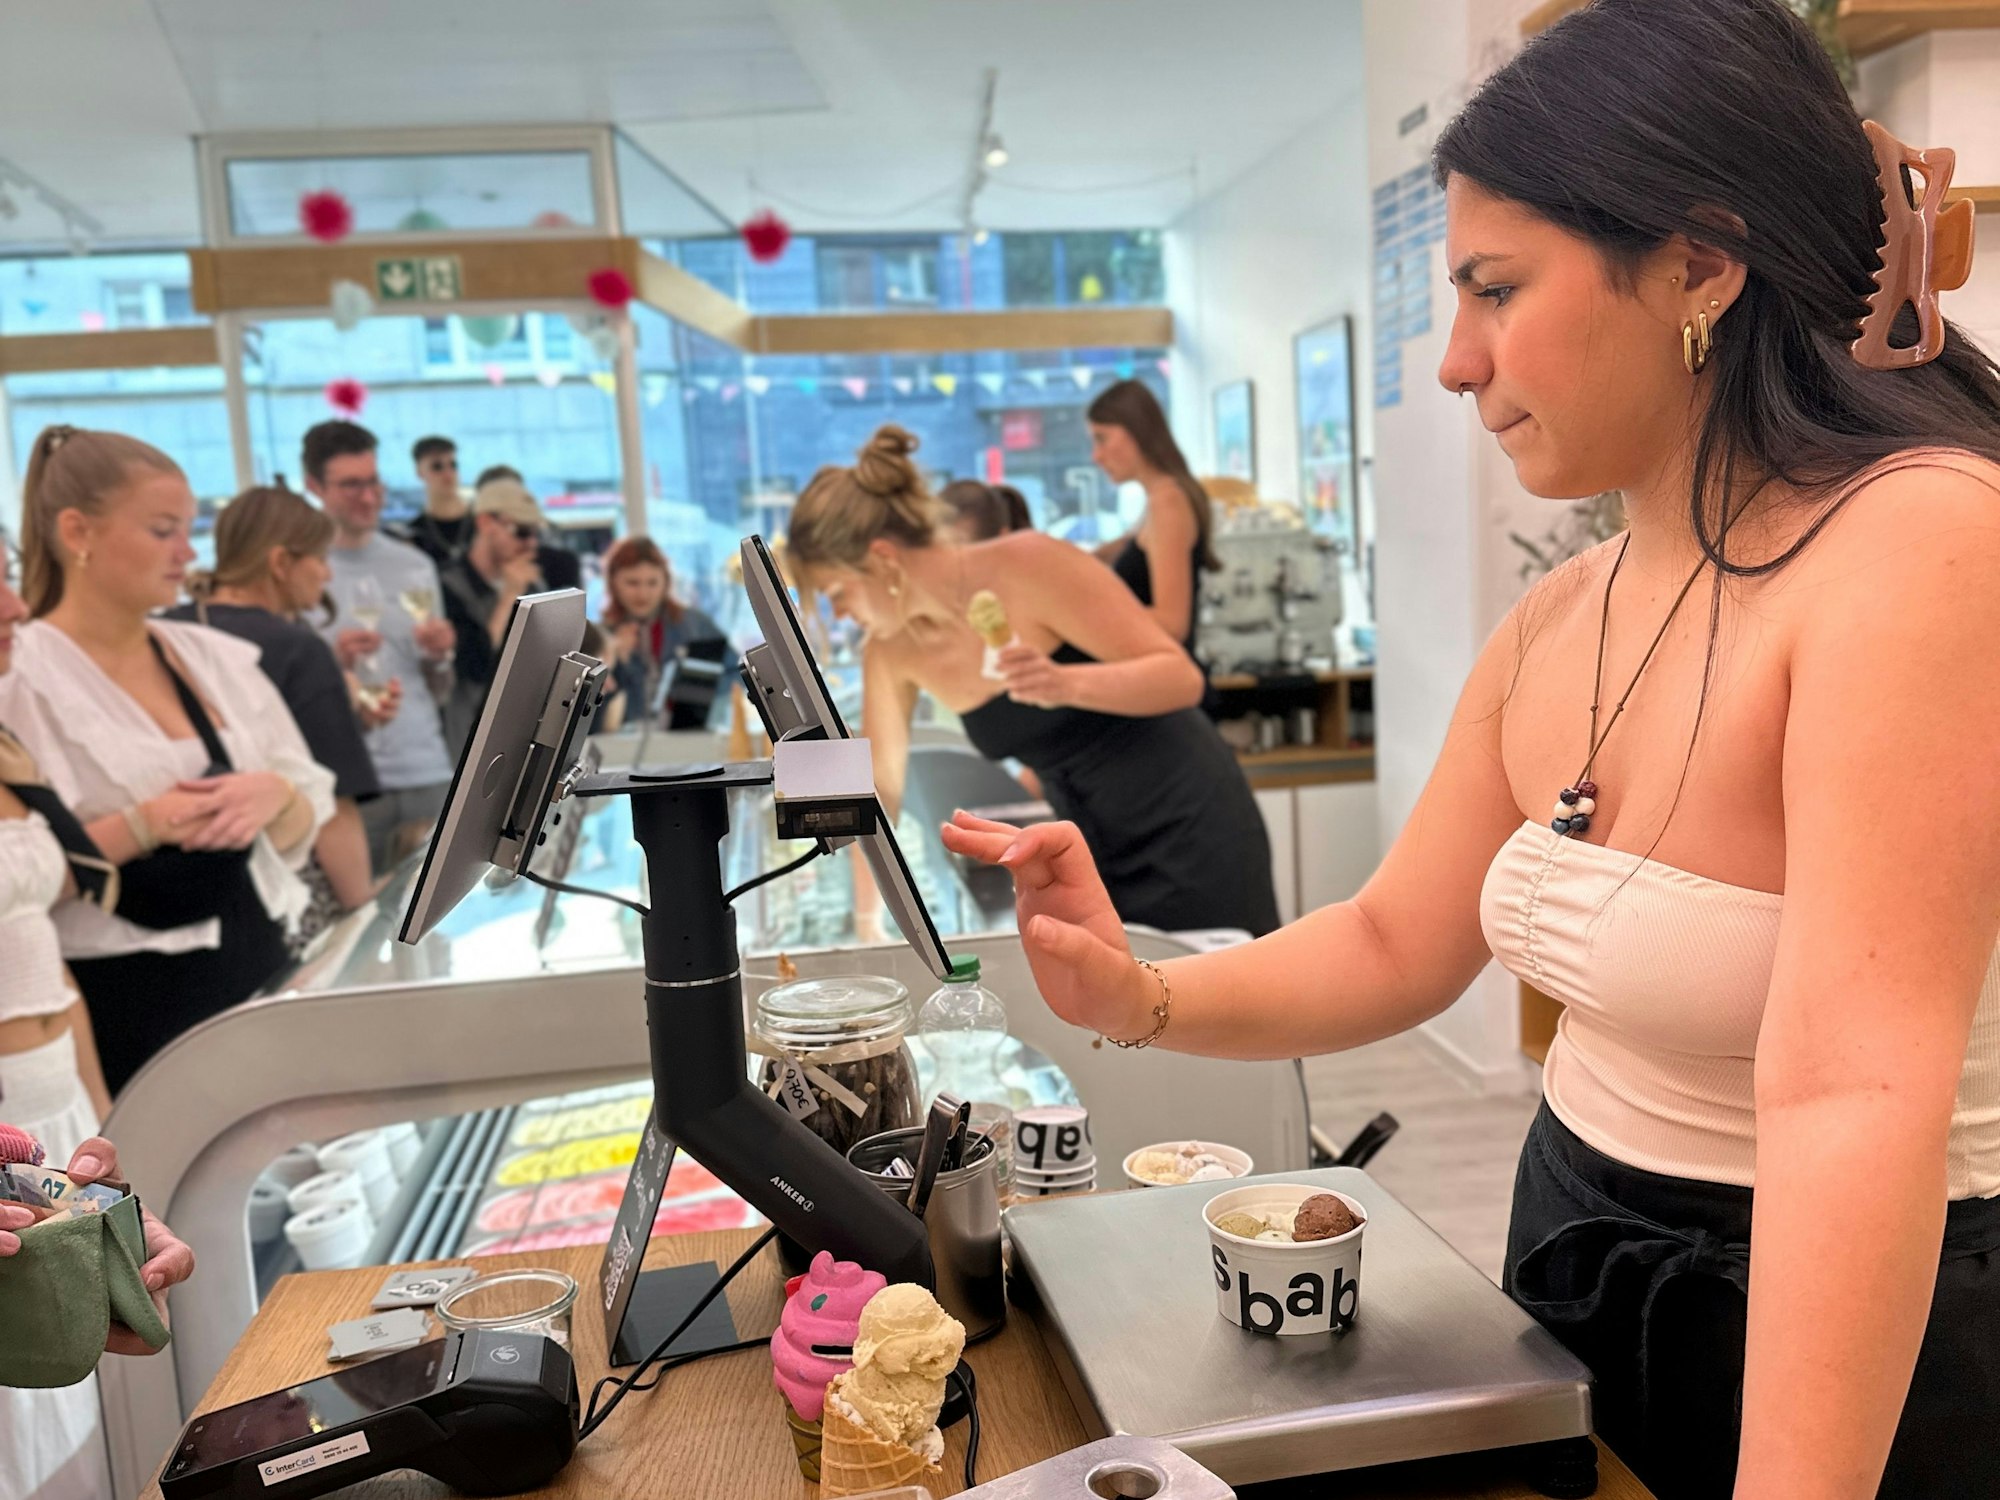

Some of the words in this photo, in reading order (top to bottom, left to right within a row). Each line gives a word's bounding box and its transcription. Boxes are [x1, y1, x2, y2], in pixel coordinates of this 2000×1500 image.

[1018, 1116, 1091, 1169] ab
[770, 1176, 806, 1206] ANKER
[276, 1455, 315, 1474] InterCard
